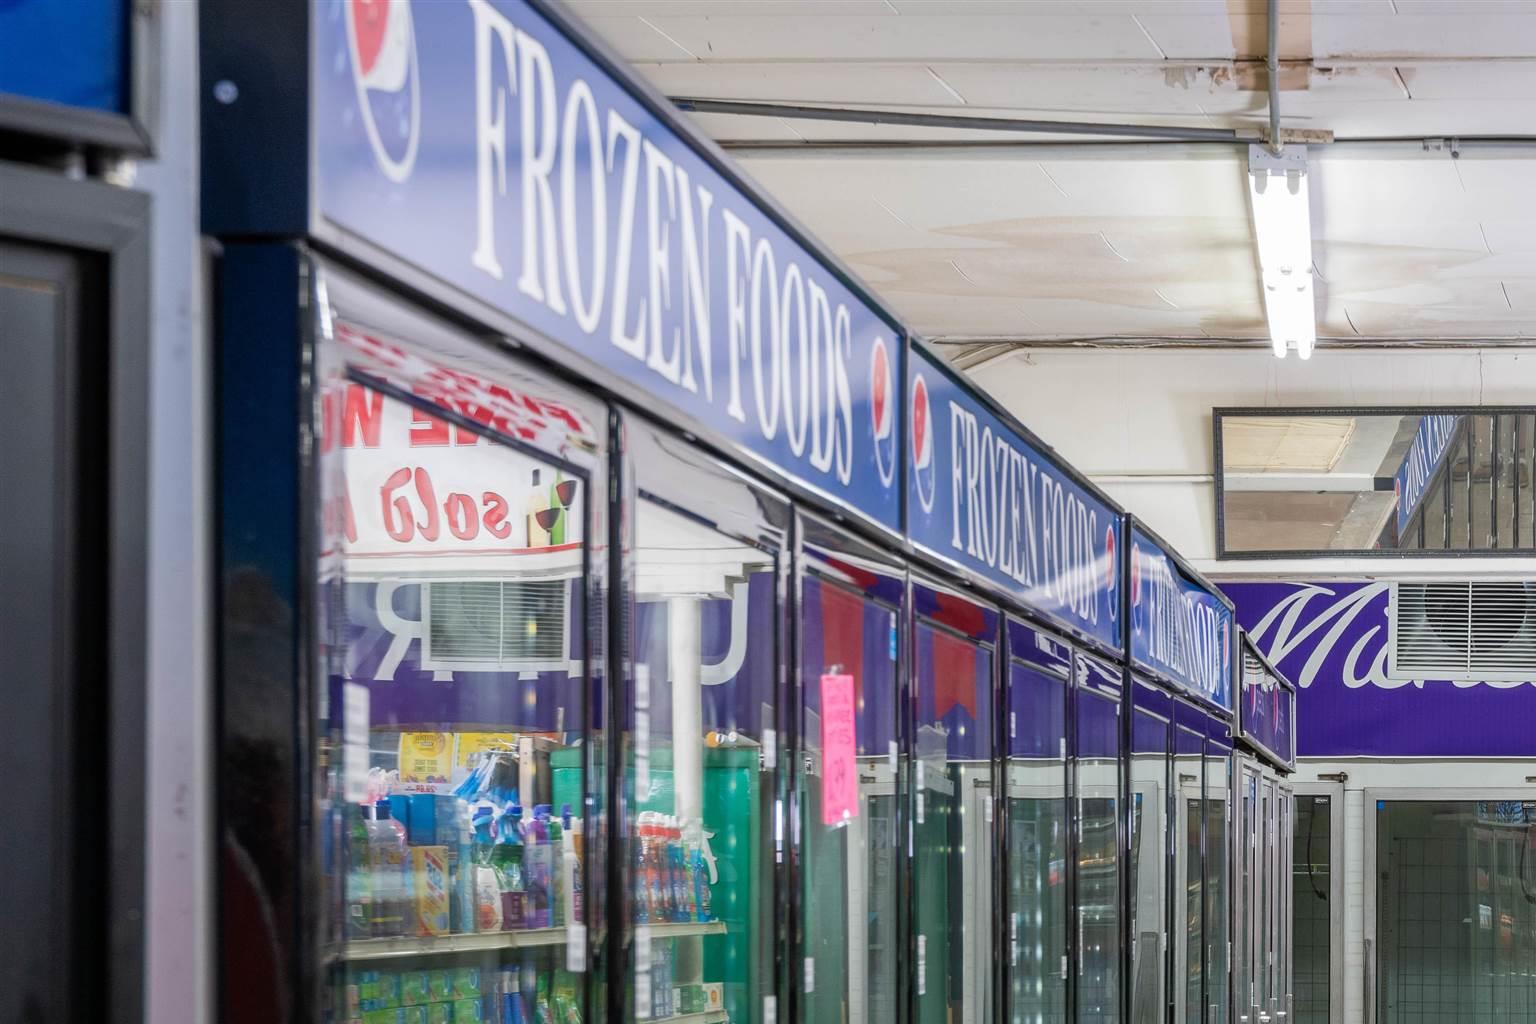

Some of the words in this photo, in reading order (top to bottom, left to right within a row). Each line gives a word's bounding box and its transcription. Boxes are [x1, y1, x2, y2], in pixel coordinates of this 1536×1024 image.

[472, 0, 714, 402] FROZEN
[723, 208, 852, 487] FOODS
[949, 400, 1038, 588] FROZEN
[1040, 471, 1098, 626] FOODS
